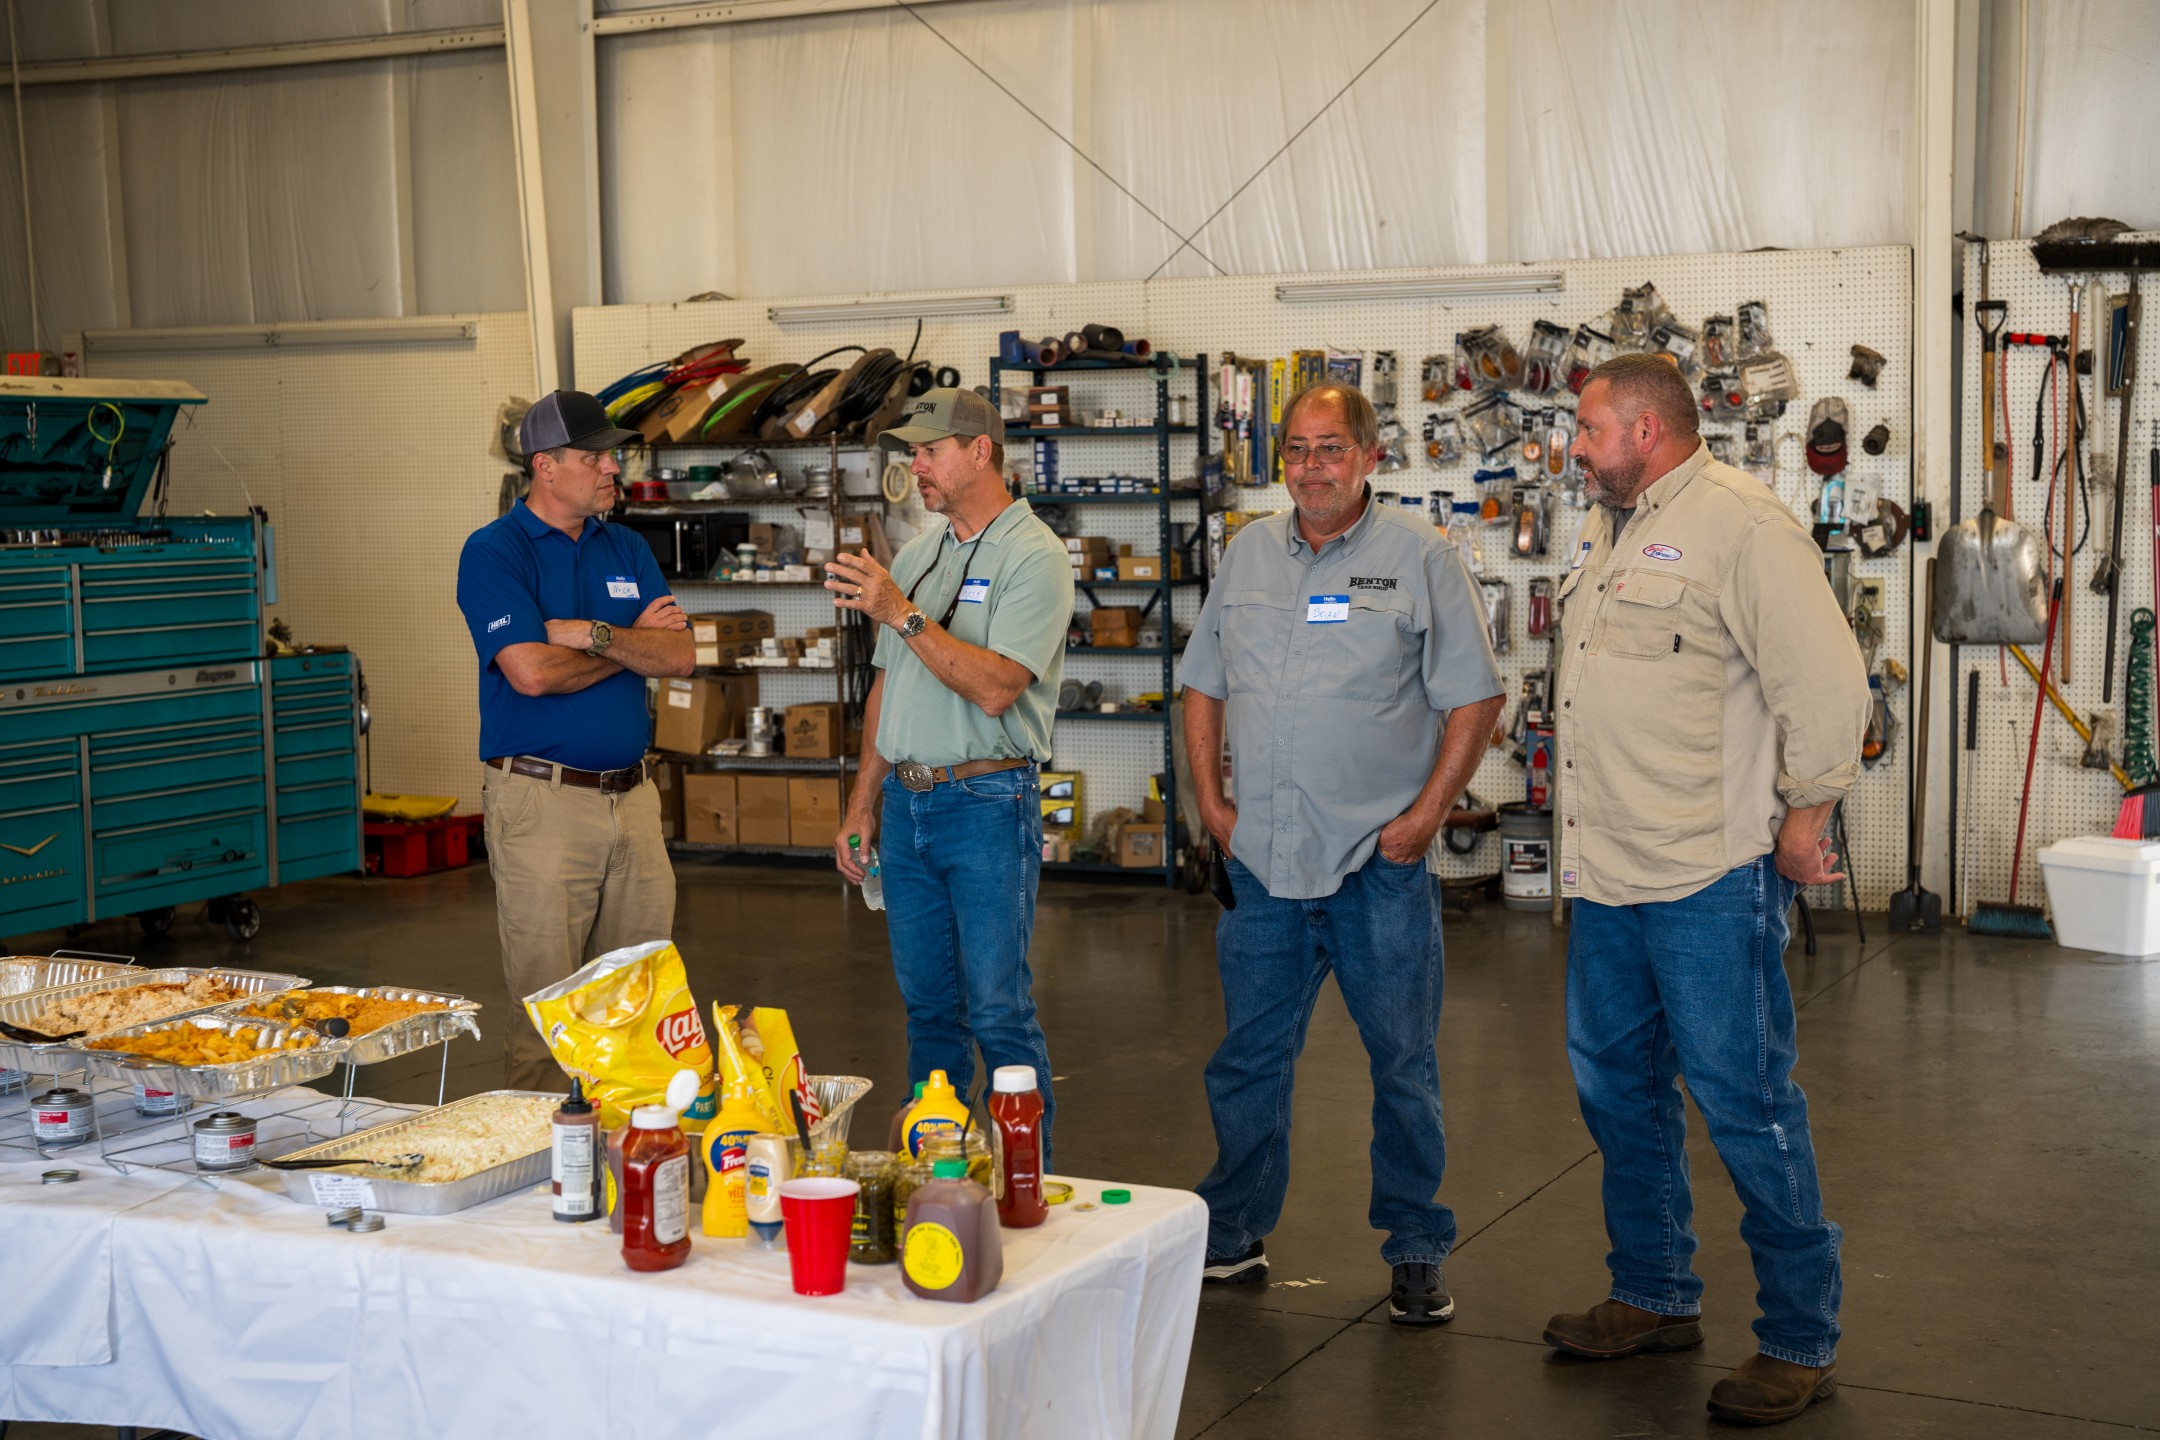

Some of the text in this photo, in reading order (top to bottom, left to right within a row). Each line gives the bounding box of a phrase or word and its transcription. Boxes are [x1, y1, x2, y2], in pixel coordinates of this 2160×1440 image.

[8, 352, 40, 377] EXIT
[1348, 577, 1398, 590] BENTON
[662, 1006, 707, 1055] Lay
[916, 1122, 938, 1133] 40%
[720, 1134, 741, 1147] 40%
[722, 1154, 746, 1171] Fren
